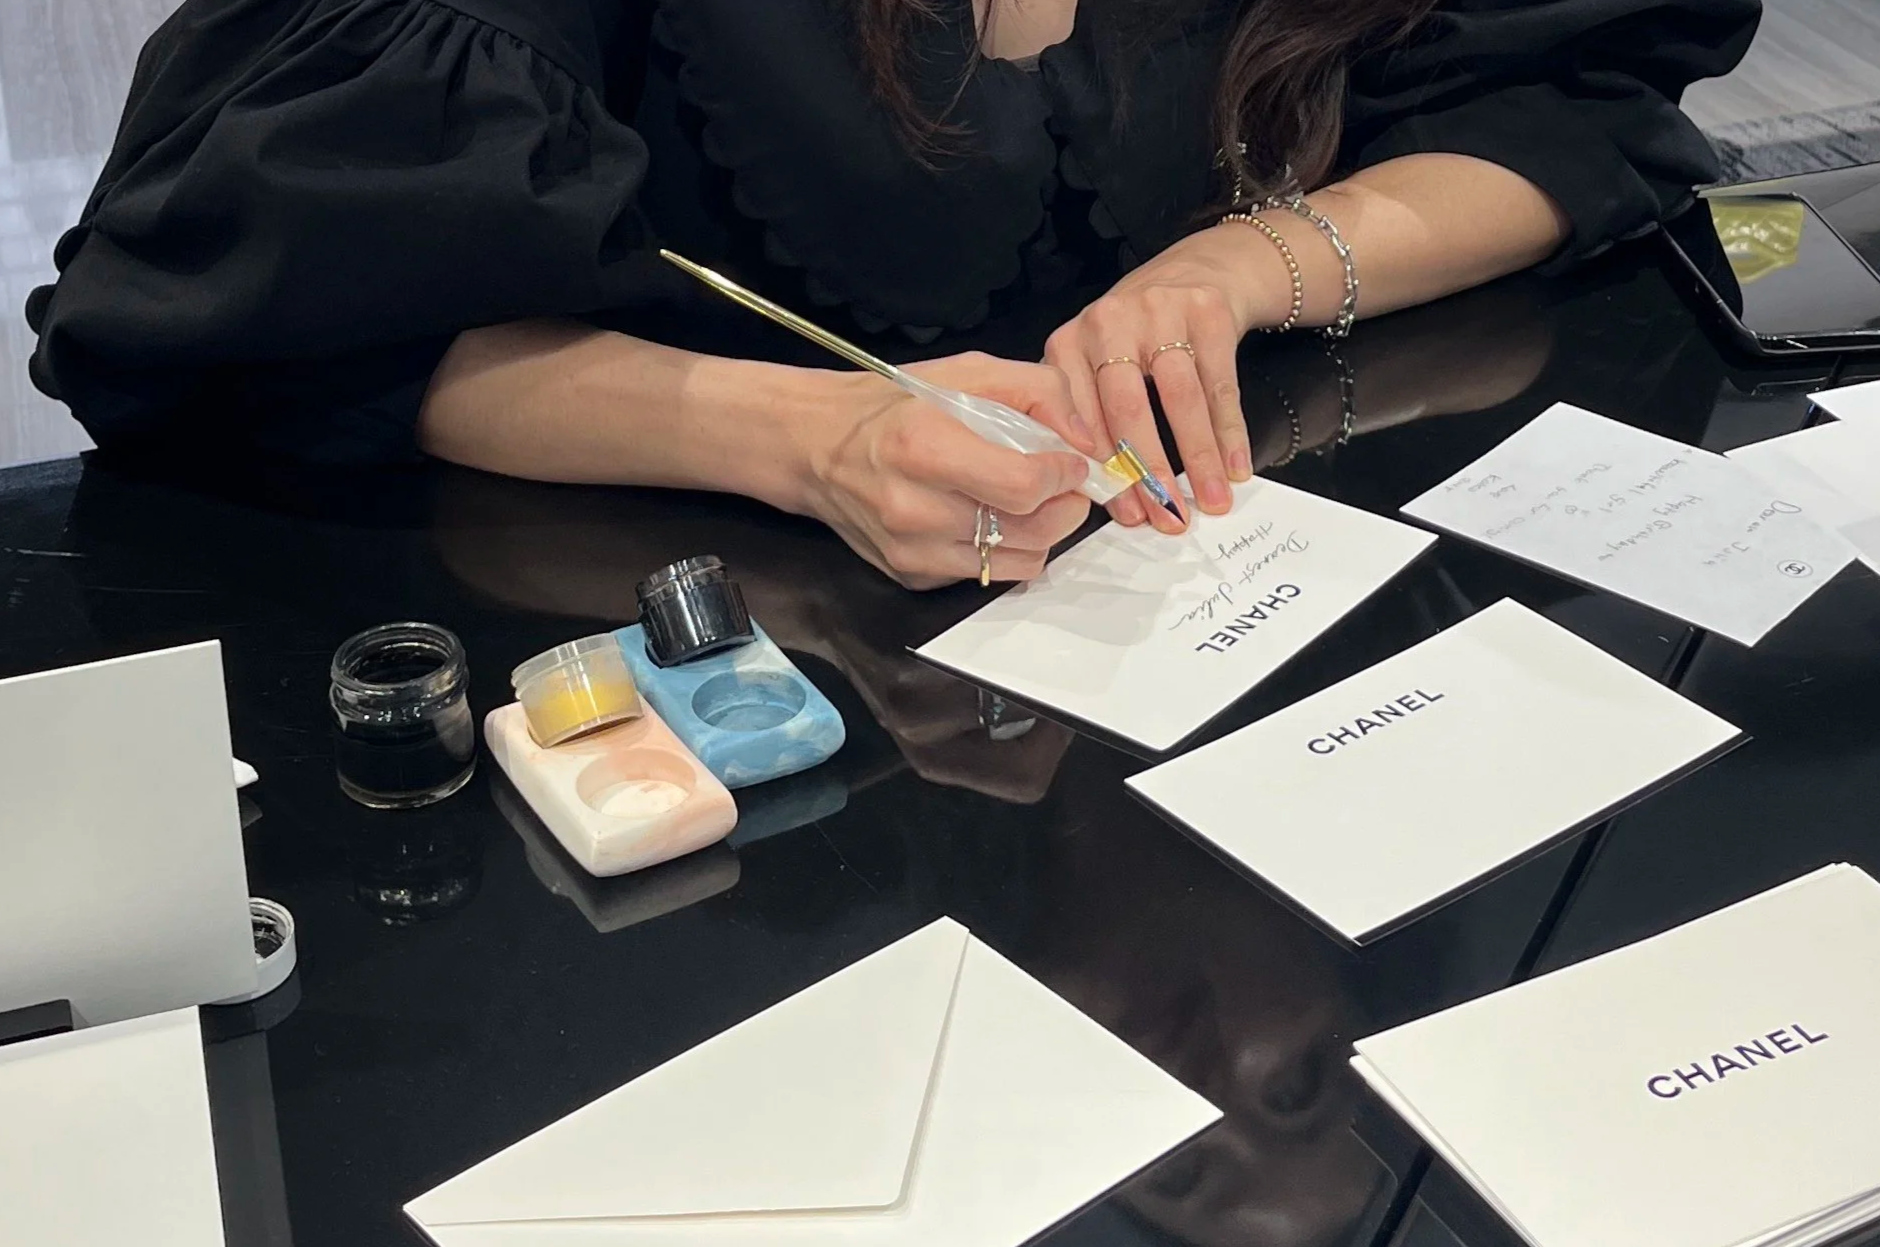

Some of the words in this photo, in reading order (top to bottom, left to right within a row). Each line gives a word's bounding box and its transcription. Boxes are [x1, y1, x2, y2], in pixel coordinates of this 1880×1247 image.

[1652, 494, 1703, 516] Happy
[1215, 521, 1274, 562] Happy
[1238, 529, 1310, 586] Dearest
[1167, 581, 1234, 631] Julia
[1195, 583, 1302, 653] CHANEL
[1307, 689, 1445, 755] CHANEL
[1647, 1023, 1830, 1099] CHANEL
